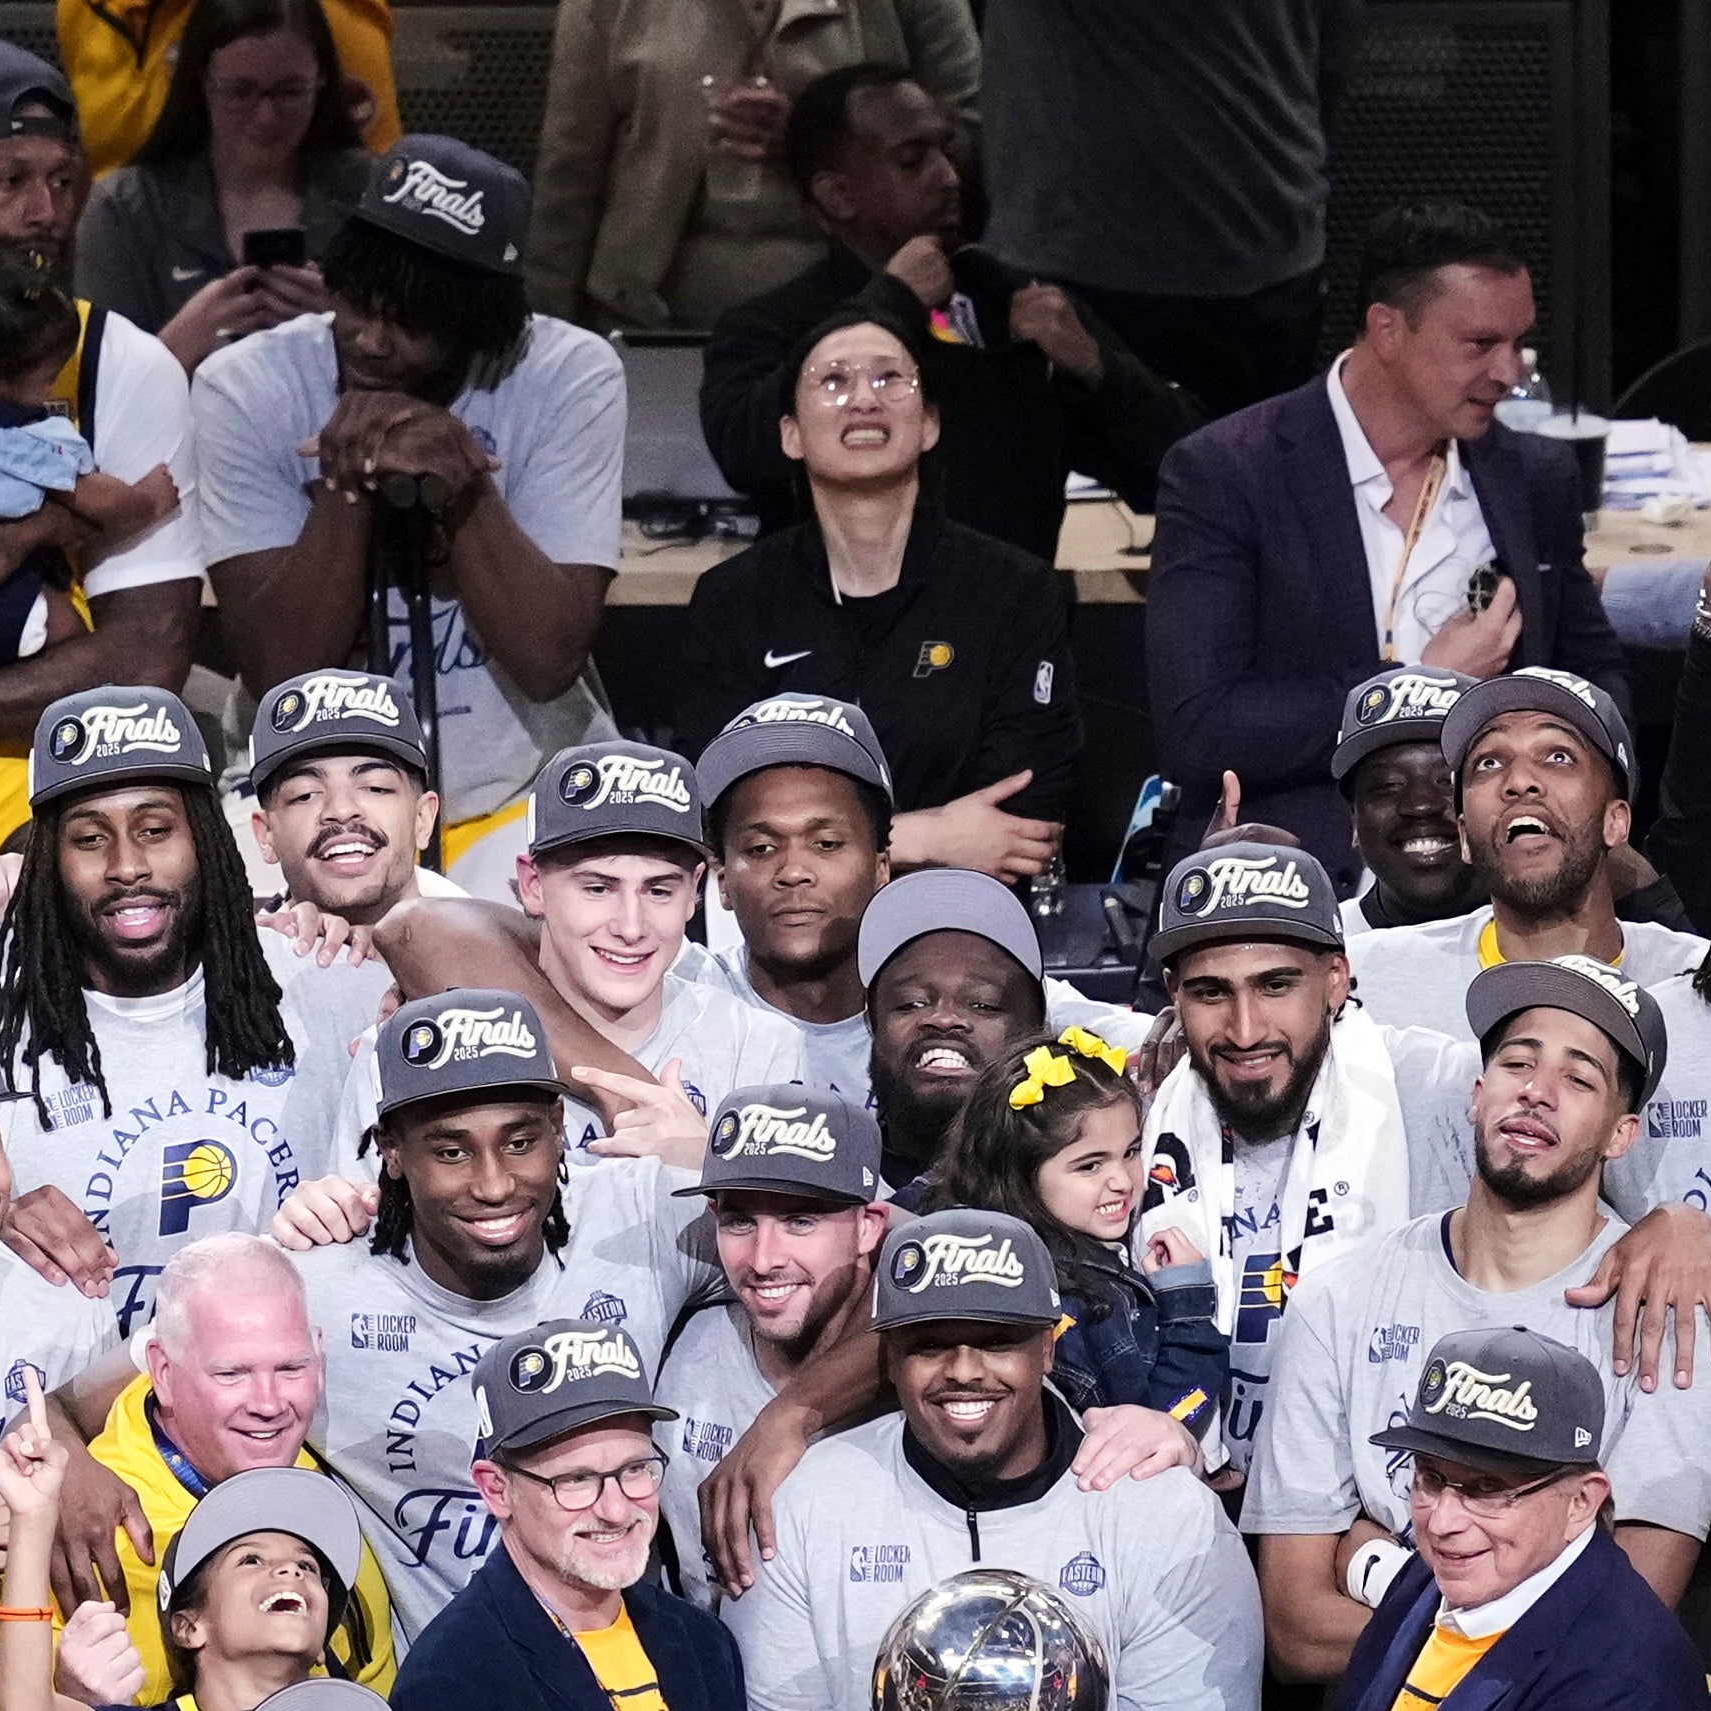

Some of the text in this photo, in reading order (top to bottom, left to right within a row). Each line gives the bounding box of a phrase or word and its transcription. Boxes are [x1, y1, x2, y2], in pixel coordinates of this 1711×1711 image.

[383, 160, 486, 236] Finals
[292, 676, 399, 731] Finals
[1383, 674, 1461, 722] Fina
[315, 707, 341, 721] 2025
[1399, 704, 1423, 717] 2025
[71, 703, 181, 764] Finals
[97, 744, 120, 757] 2025
[582, 755, 691, 812] Finals
[609, 789, 634, 804] 2025
[1198, 856, 1309, 916] Finals
[1220, 894, 1244, 908] 2025
[428, 1007, 536, 1069] Finals
[454, 1044, 479, 1060] 2025
[58, 1083, 95, 1109] LOCKER
[64, 1105, 93, 1127] ROOM
[1673, 1100, 1708, 1120] LOCKER
[722, 1102, 836, 1161] Finals
[1673, 1119, 1701, 1137] ROOM
[743, 1141, 766, 1156] 2025
[88, 1090, 299, 1240] NDIANA PACER
[913, 1234, 1023, 1291] Finals
[934, 1272, 959, 1286] 2025
[377, 1314, 416, 1333] LOCKER
[377, 1333, 408, 1352] ROOM
[542, 1330, 641, 1392] Finals
[566, 1365, 592, 1380] 2025
[1427, 1361, 1538, 1430] Finals
[384, 1345, 482, 1473] INDIAN
[1446, 1403, 1466, 1419] 2025
[699, 1421, 732, 1446] LOCKER
[696, 1443, 722, 1462] ROOM
[875, 1545, 911, 1564] LOCKER
[874, 1564, 903, 1583] ROOM
